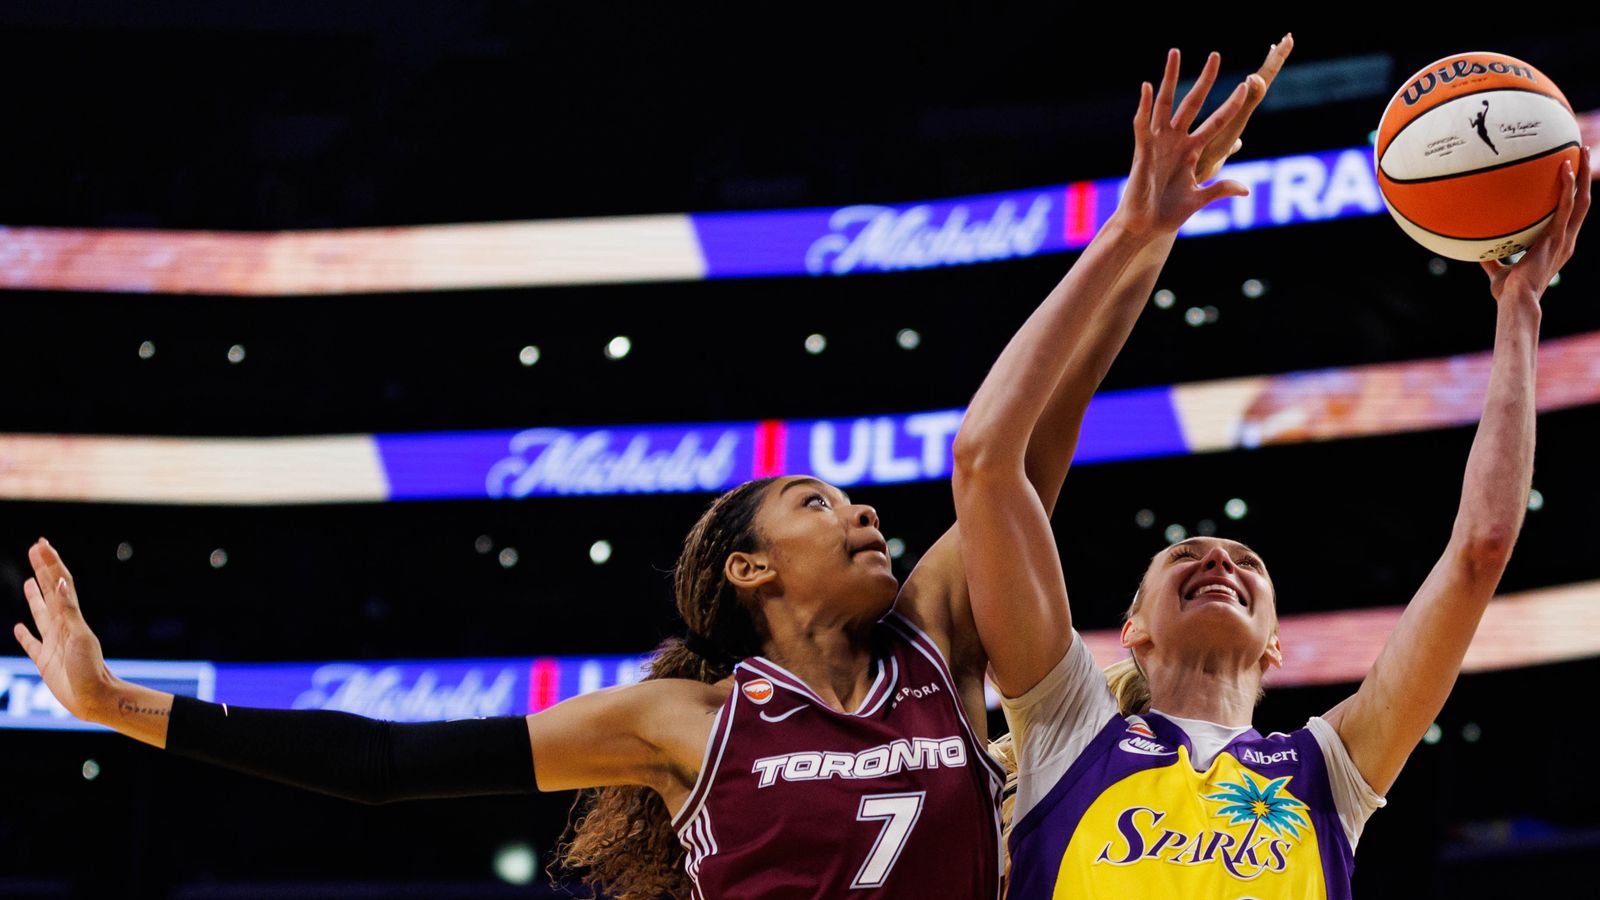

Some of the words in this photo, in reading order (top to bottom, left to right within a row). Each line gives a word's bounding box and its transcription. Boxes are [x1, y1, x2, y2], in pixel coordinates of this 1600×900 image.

[1401, 60, 1537, 106] Wilson
[892, 682, 941, 709] EPORA
[752, 735, 967, 788] TORONTO
[1128, 736, 1168, 753] NIKE
[1243, 748, 1299, 765] Albert
[850, 791, 927, 889] 7
